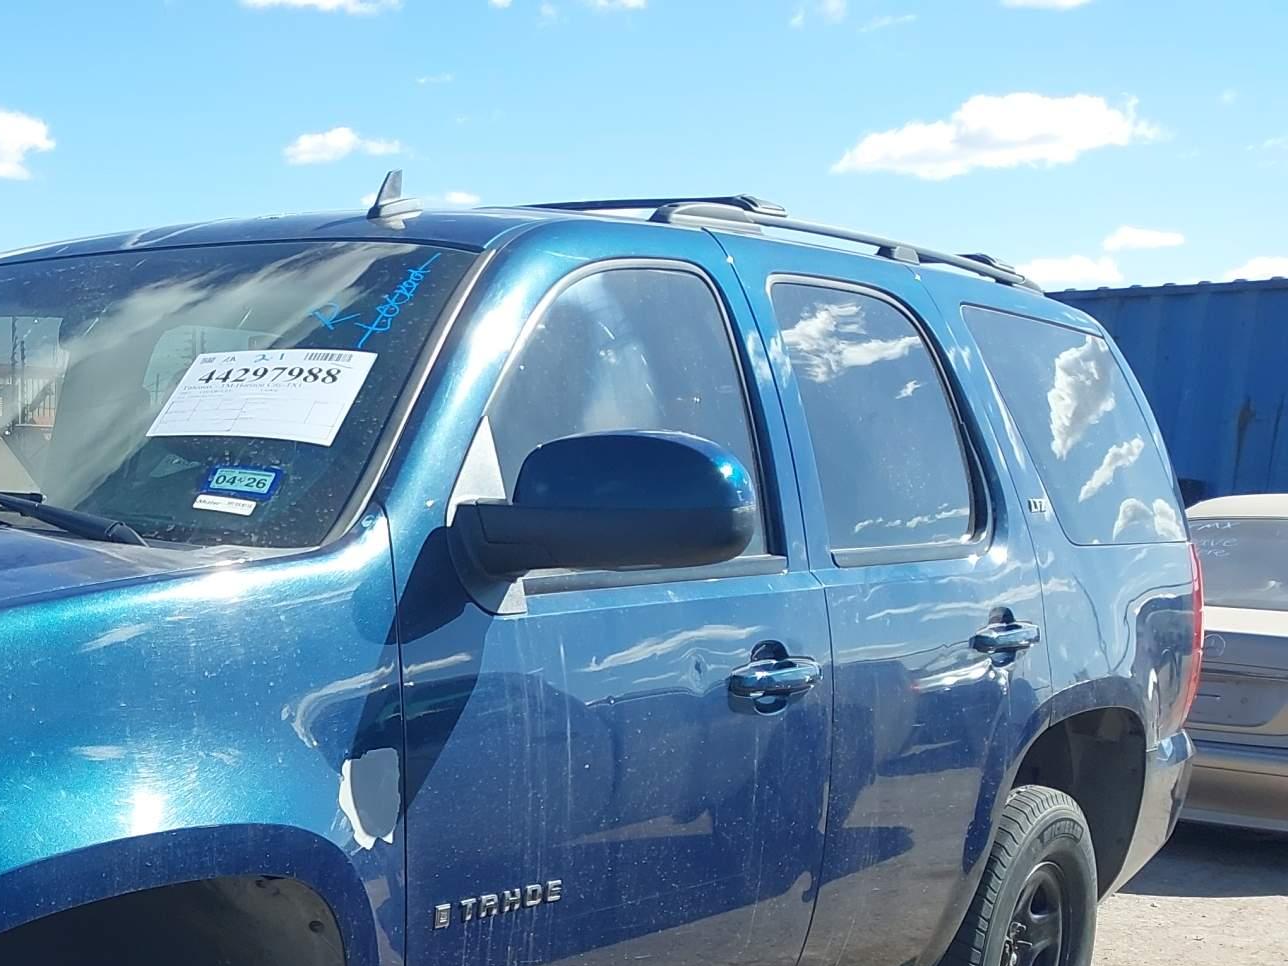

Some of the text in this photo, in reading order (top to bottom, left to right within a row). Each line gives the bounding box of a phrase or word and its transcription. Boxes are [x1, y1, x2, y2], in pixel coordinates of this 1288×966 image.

[198, 366, 342, 385] 44297988
[215, 475, 268, 489] 04 26
[460, 879, 562, 921] TAHOE
